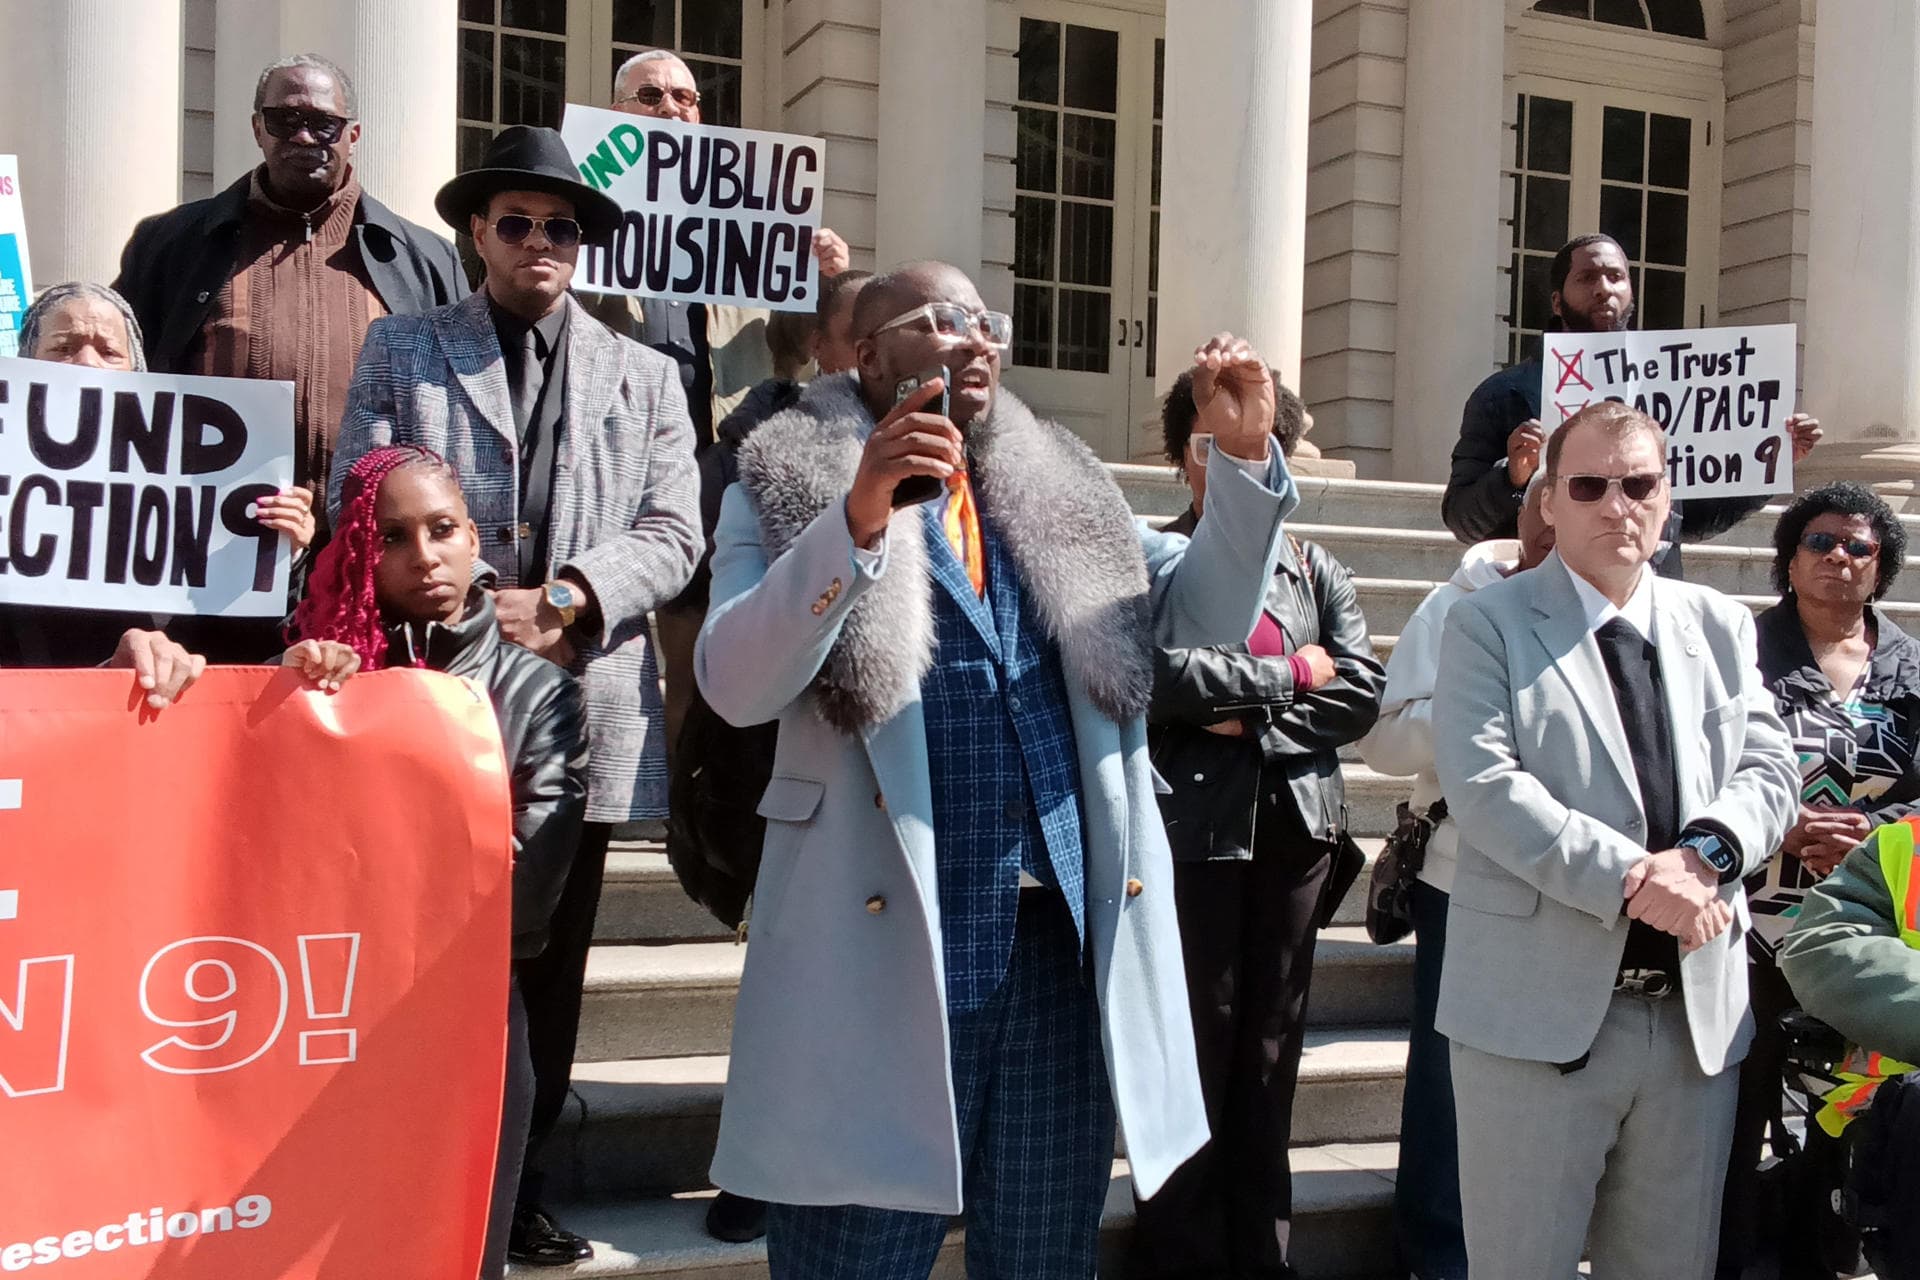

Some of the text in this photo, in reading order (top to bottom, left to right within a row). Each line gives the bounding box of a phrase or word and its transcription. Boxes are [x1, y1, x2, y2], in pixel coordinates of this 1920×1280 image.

[646, 130, 817, 215] PUBLIC
[1594, 337, 1755, 385] The Trust
[0, 379, 248, 475] UND
[1754, 435, 1781, 484] 9
[139, 932, 361, 1075] 9!
